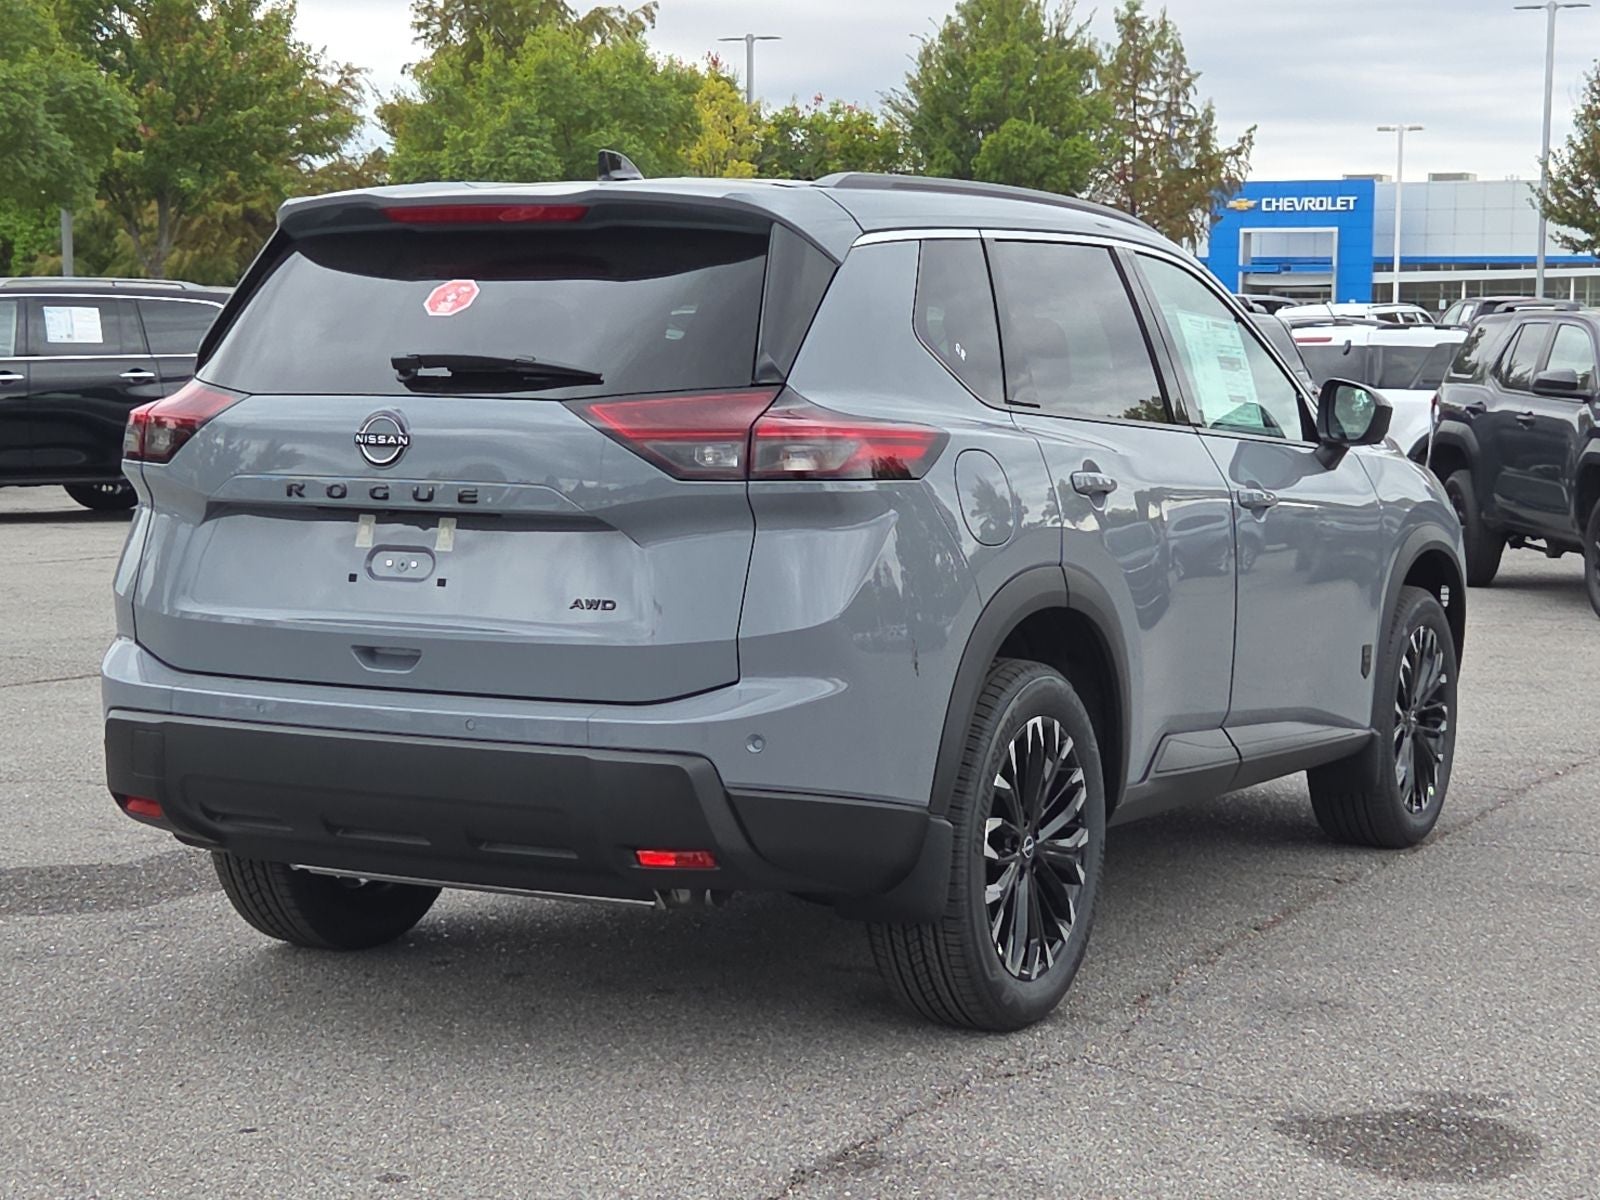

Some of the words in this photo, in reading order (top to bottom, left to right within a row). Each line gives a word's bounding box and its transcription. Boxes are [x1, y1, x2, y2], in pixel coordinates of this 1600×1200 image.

[1261, 196, 1358, 212] CHEVROLET
[355, 433, 409, 446] NISSAN
[286, 482, 479, 504] ROGUE
[569, 598, 617, 611] AWD
